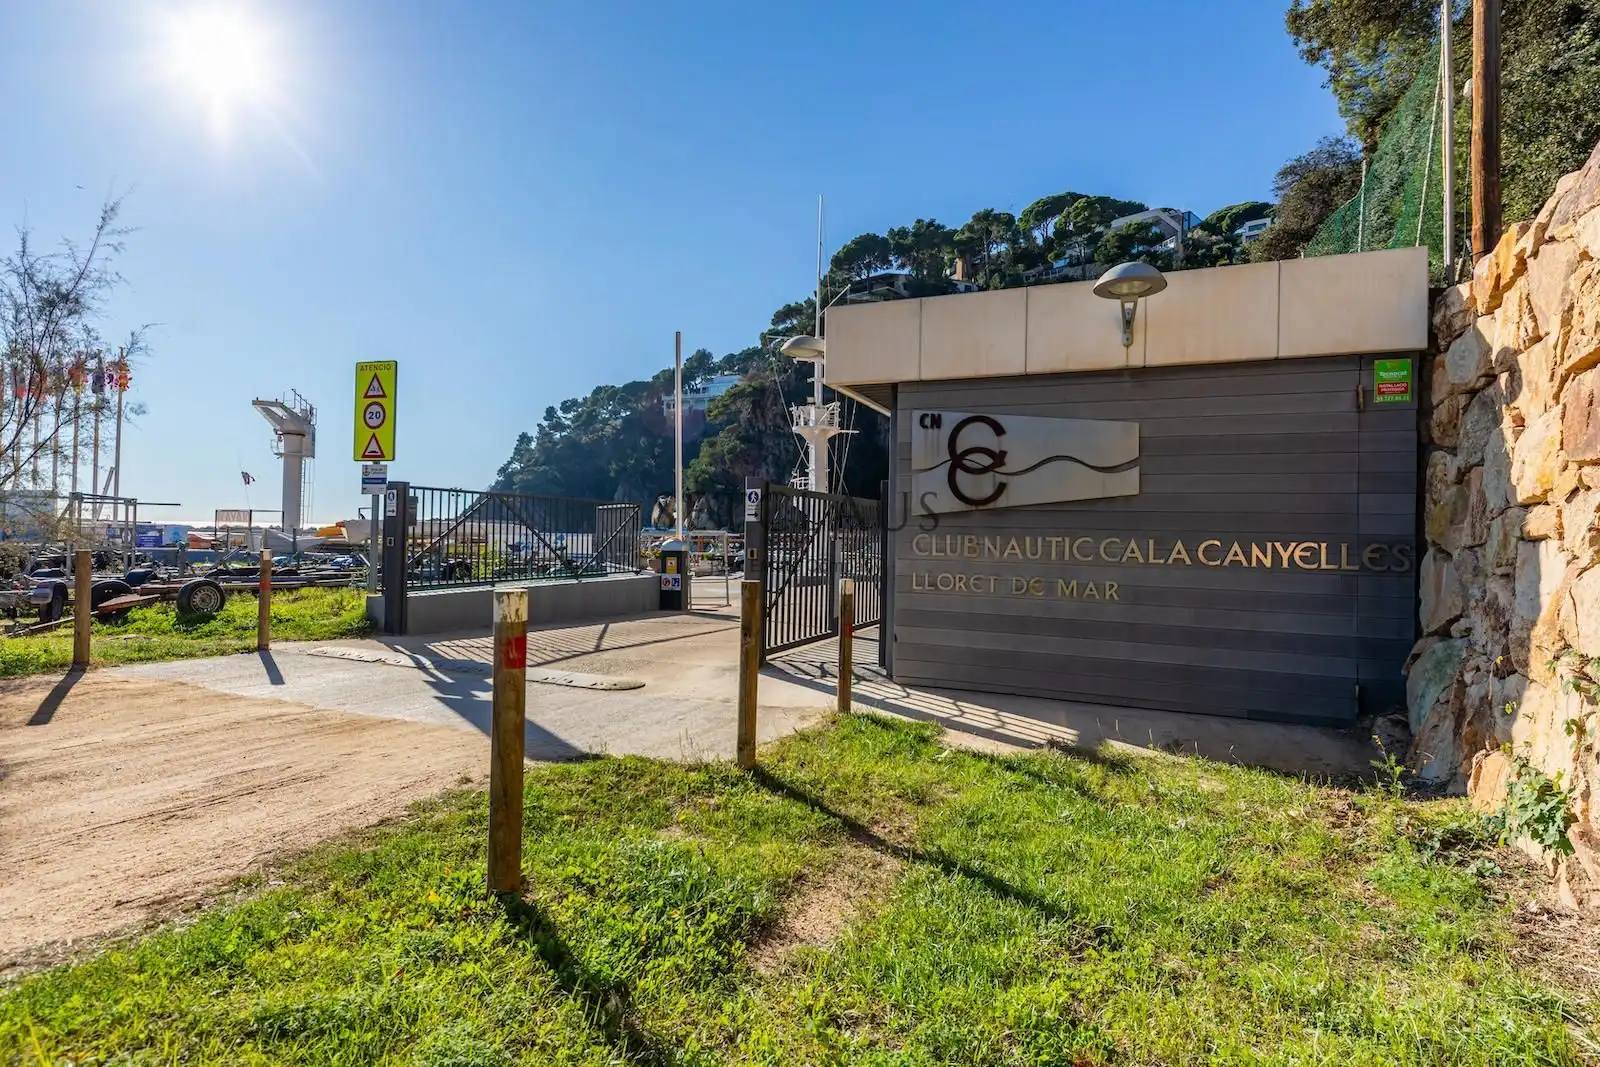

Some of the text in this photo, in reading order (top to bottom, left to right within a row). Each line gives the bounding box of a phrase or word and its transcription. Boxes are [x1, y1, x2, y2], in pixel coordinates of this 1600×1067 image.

[368, 411, 381, 420] 20
[919, 413, 942, 429] CN
[1197, 539, 1411, 572] CANYELLES
[912, 572, 1120, 600] LLORET DE MAR
